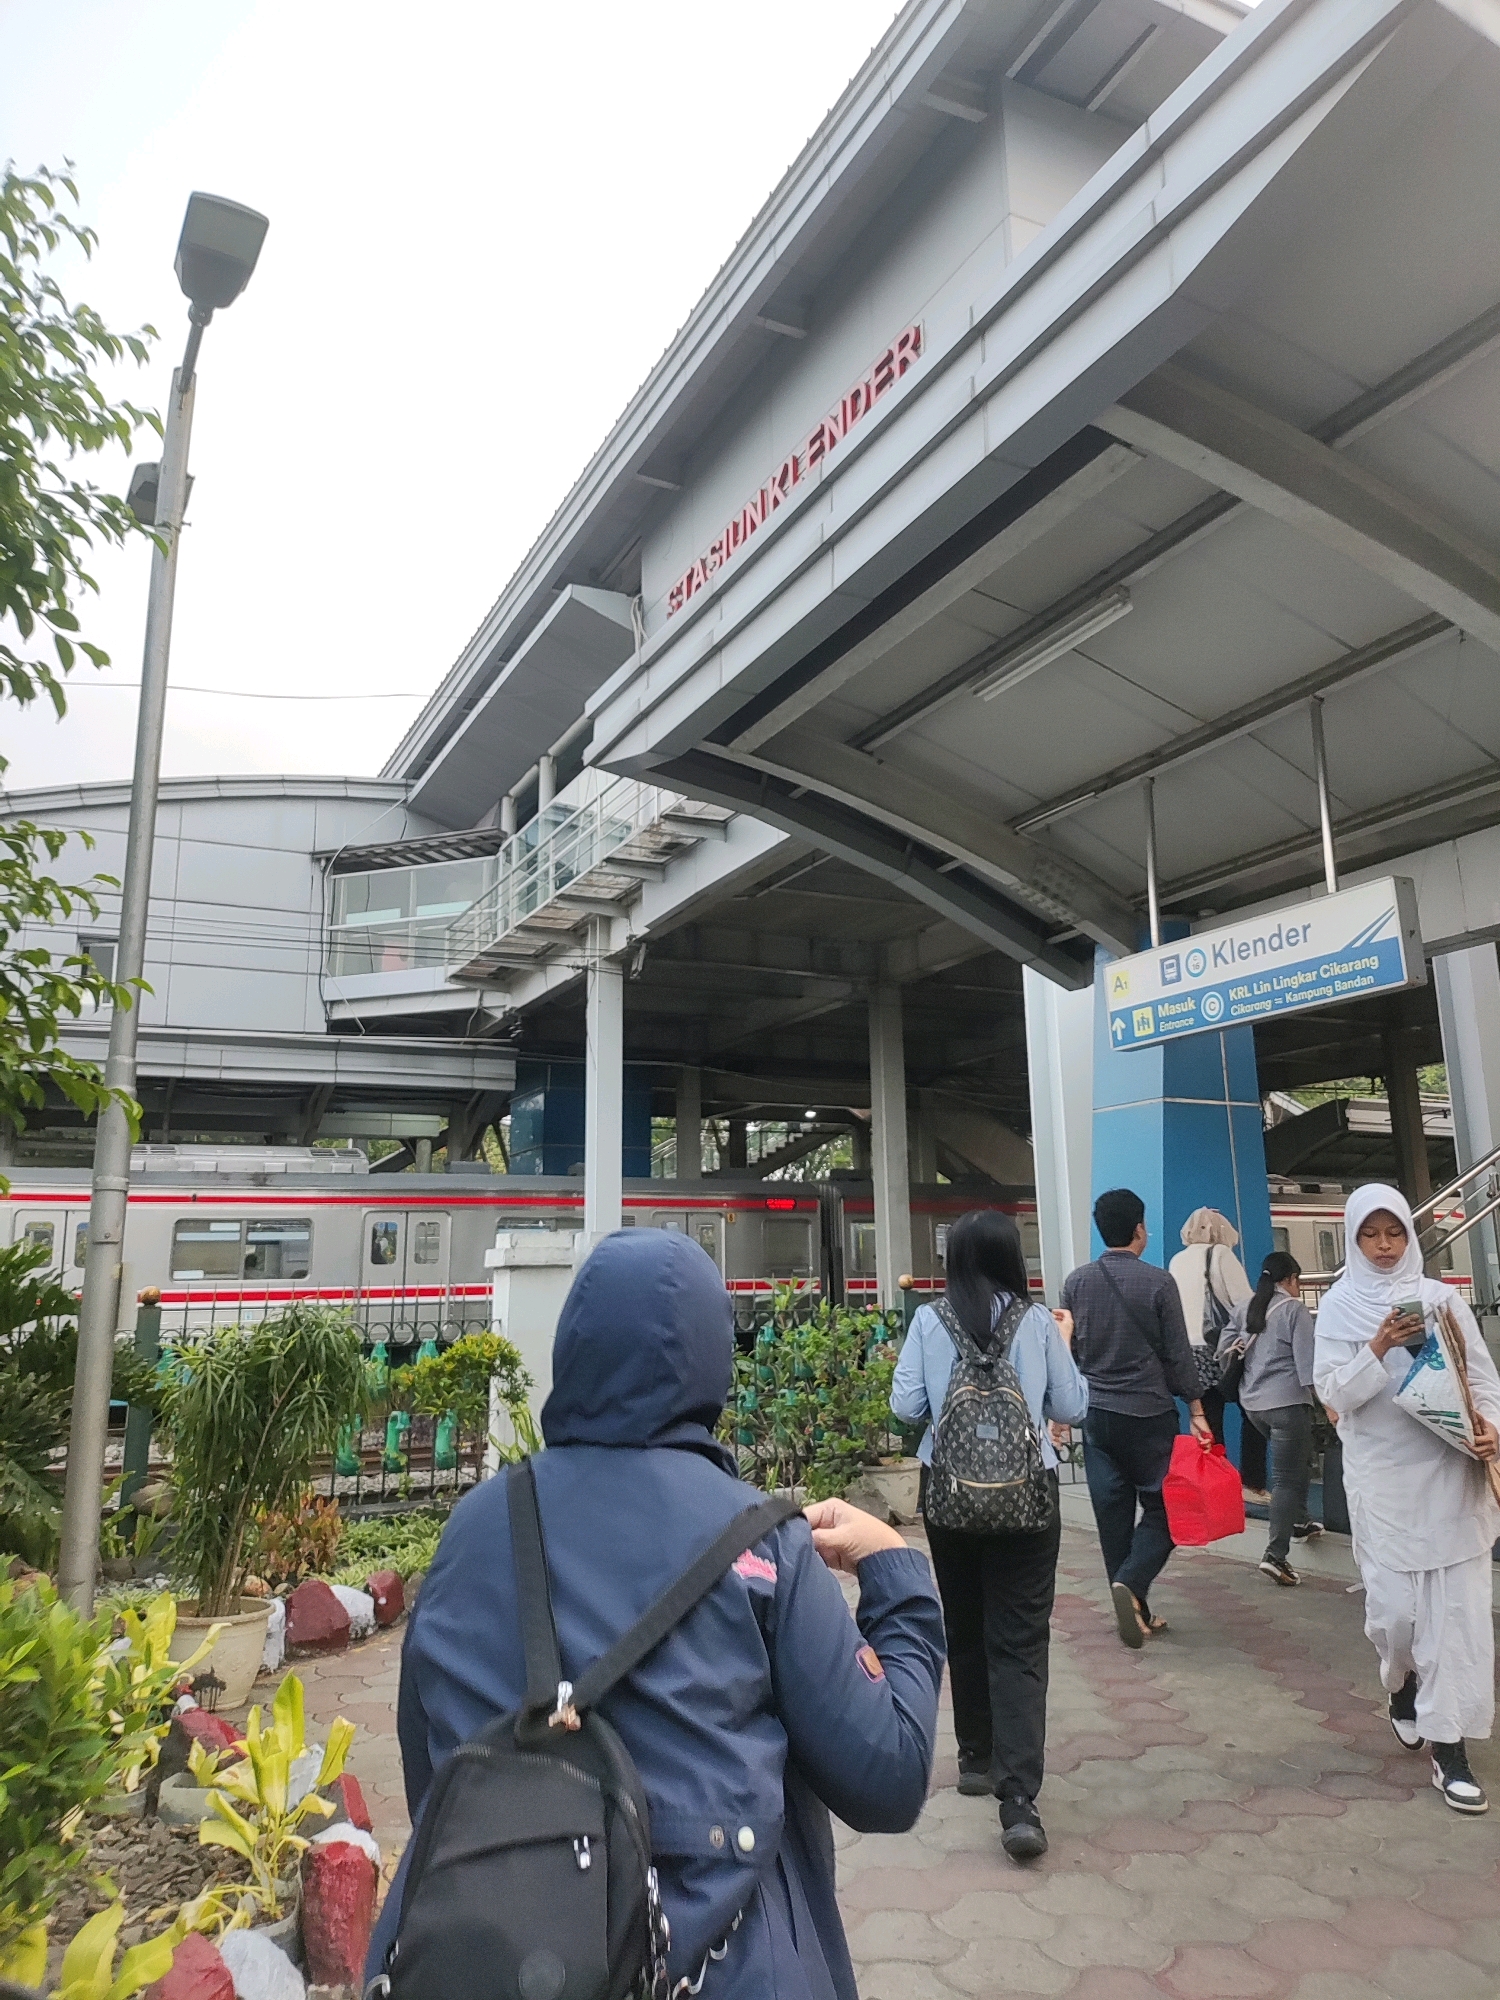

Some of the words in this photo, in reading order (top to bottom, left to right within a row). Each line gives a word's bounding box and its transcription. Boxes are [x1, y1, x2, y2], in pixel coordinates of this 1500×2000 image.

[1211, 922, 1311, 968] Klender
[1228, 986, 1252, 1001] KRL
[1253, 980, 1271, 995] Lin
[1273, 969, 1317, 990] Lingkar
[1320, 955, 1379, 979] Cikarang
[1157, 996, 1196, 1018] Masuk
[1208, 1001, 1217, 1012] C
[1230, 997, 1272, 1016] Cikarang
[1285, 983, 1333, 1003] Kampung
[1334, 975, 1374, 992] Bandan
[1159, 1017, 1194, 1032] Entrance
